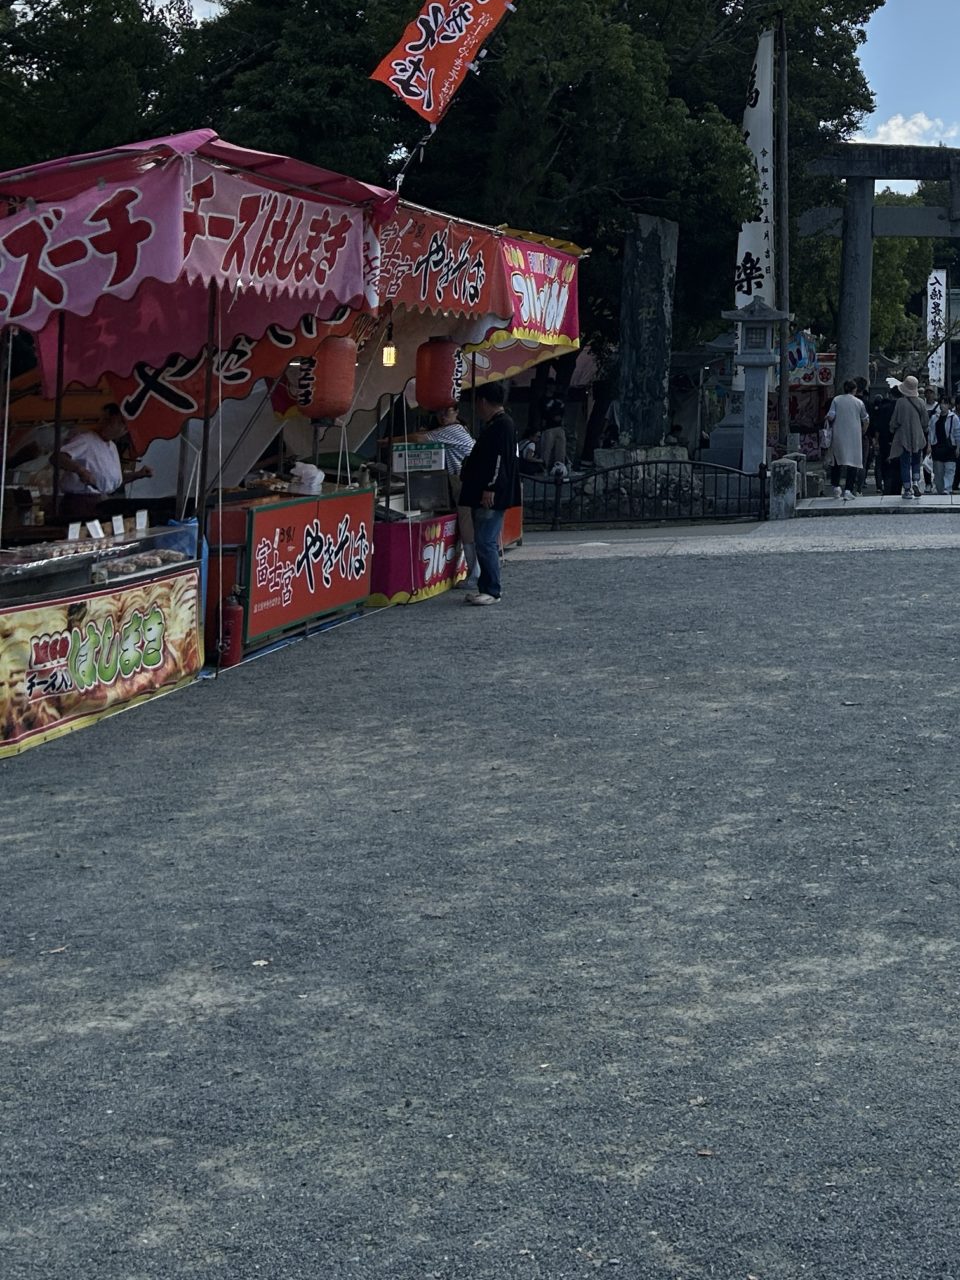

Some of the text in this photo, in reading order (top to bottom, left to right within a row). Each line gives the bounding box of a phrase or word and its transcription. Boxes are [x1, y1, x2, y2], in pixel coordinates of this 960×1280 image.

[183, 173, 353, 287] チーズはしまき
[296, 513, 374, 594] やきそば
[67, 603, 166, 694] はしまき
